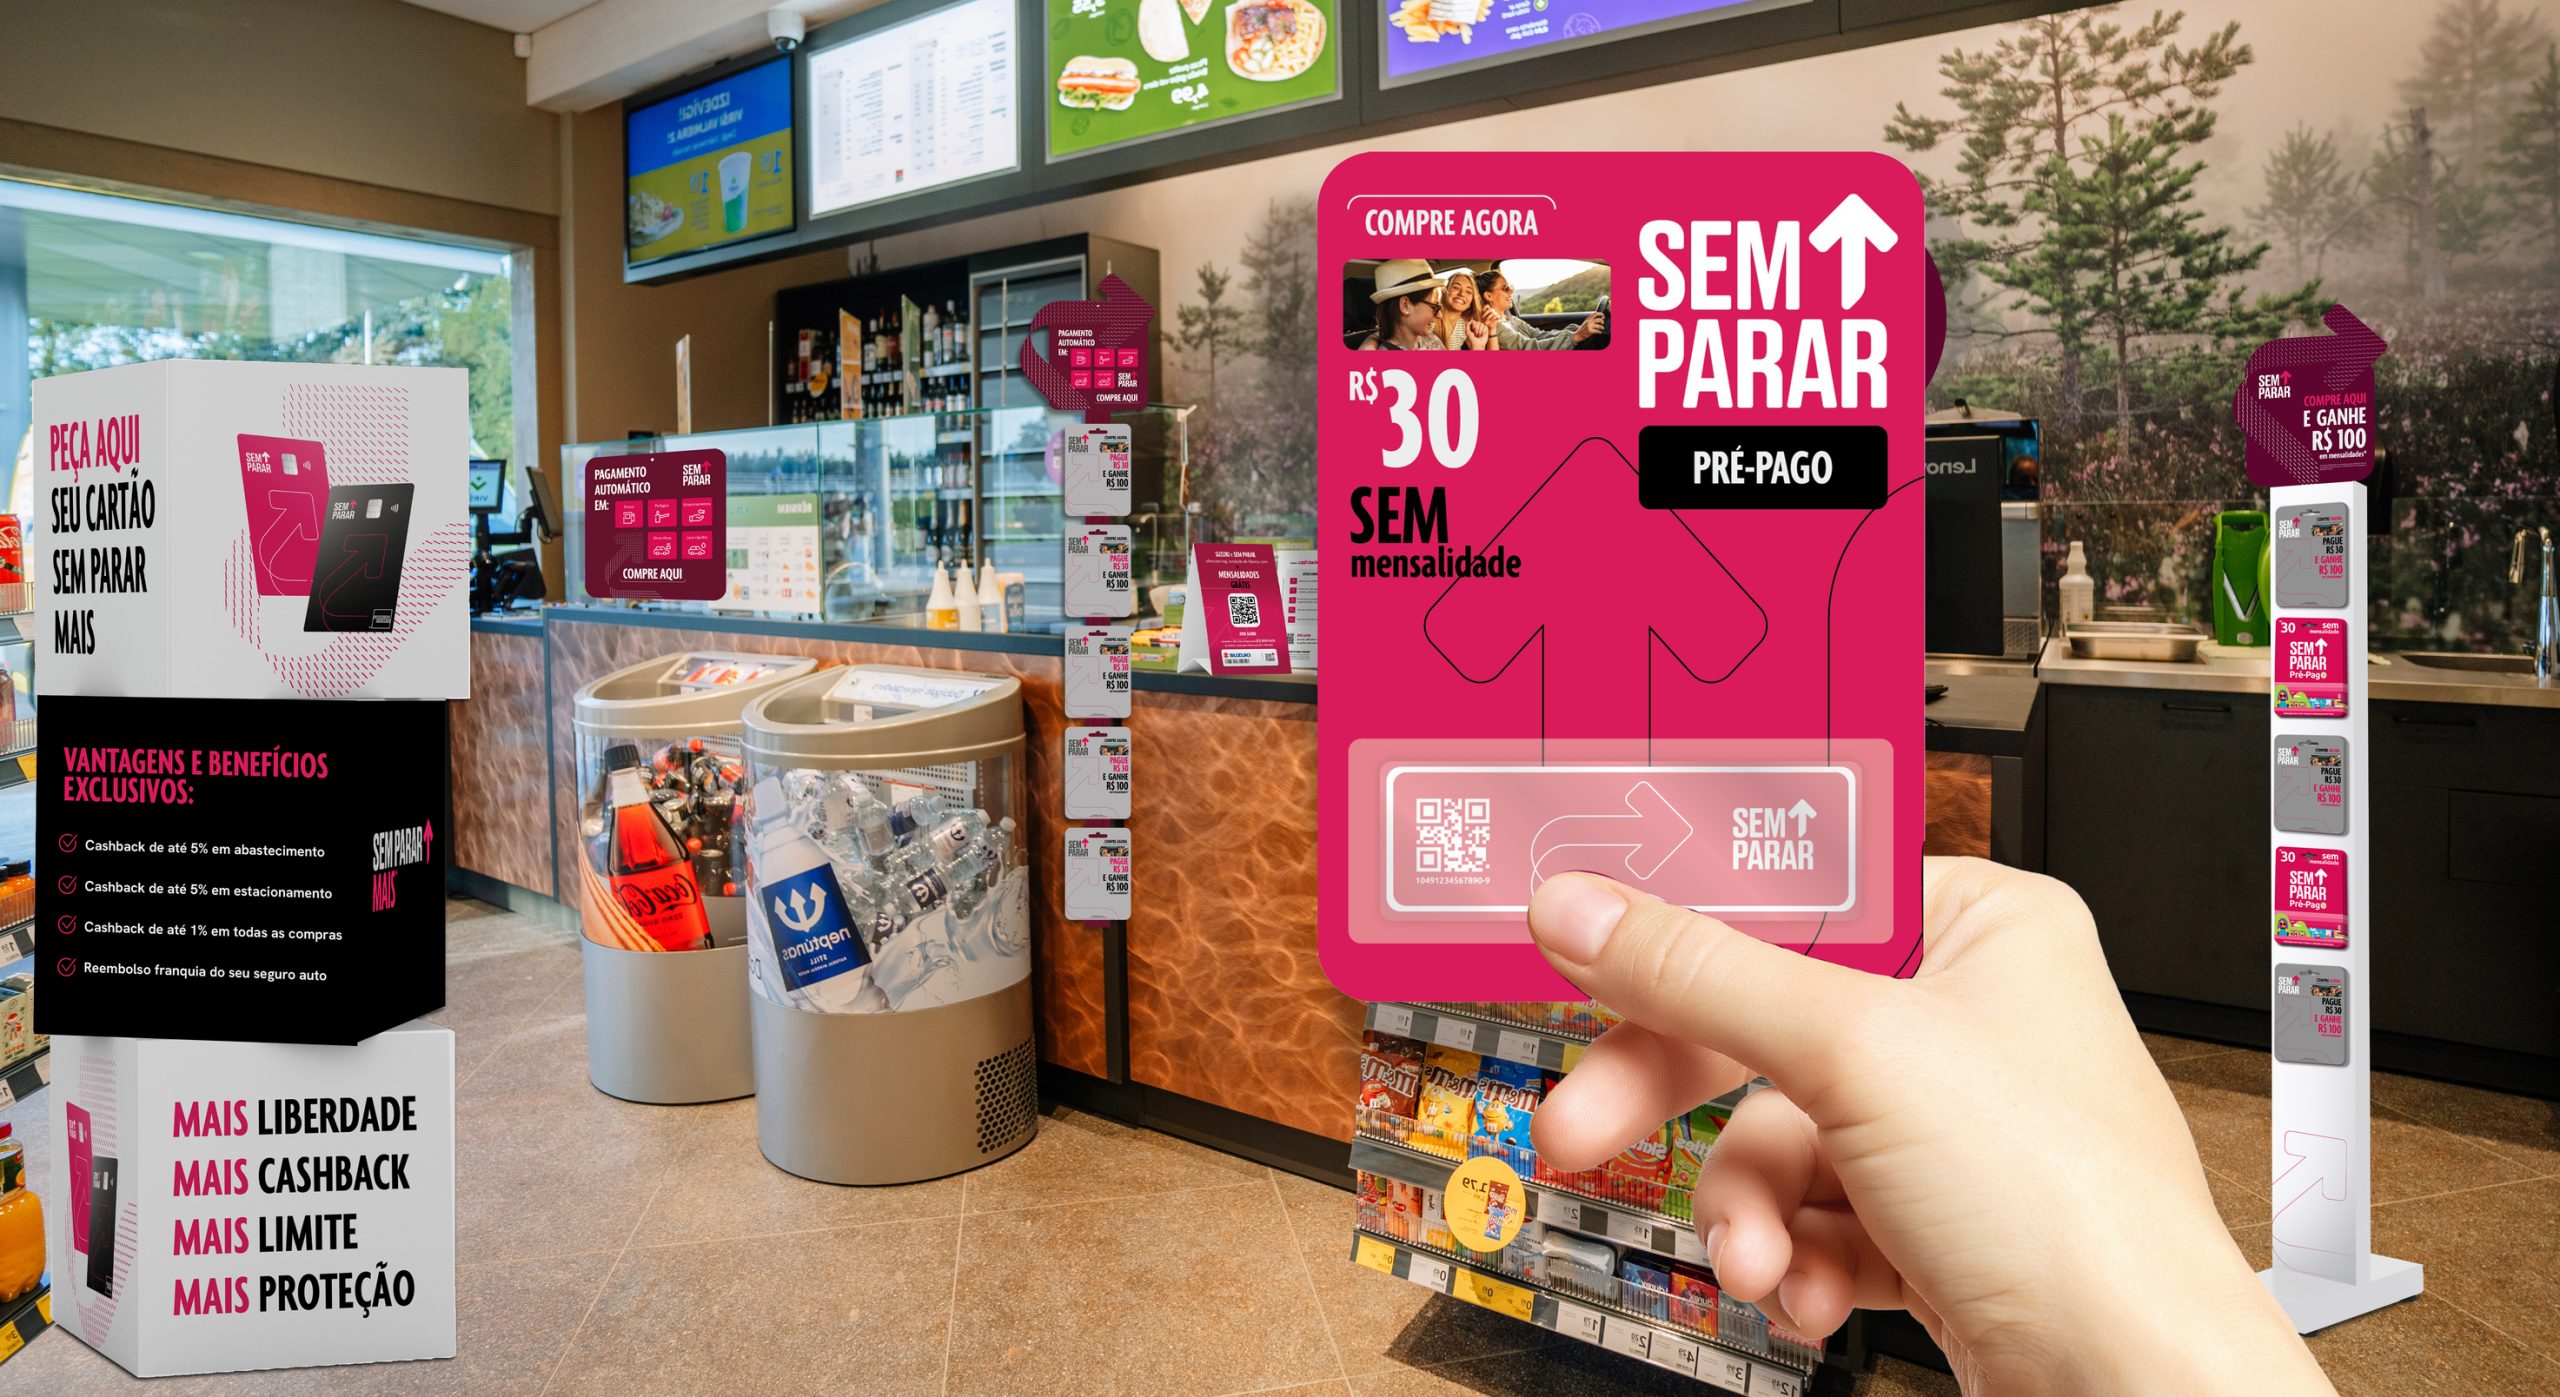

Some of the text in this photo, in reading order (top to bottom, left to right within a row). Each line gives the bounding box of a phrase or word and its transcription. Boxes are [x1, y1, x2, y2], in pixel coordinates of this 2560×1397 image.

[1365, 208, 1539, 237] COMPRE AGORA
[1638, 219, 1801, 311] SEM
[1058, 329, 1093, 337] PAGAMENTO
[1058, 338, 1095, 346] AUTOMÁTICO
[1638, 318, 1888, 409] PARAR
[1118, 380, 1137, 388] PARAR
[2258, 374, 2279, 387] SEM
[1096, 394, 1138, 402] COMPRE AQUI
[2258, 385, 2291, 399] PARAR
[2303, 392, 2366, 407] COMPRE AQUI
[2303, 407, 2366, 427] E GANHE
[1068, 436, 1082, 444] SEM
[2312, 427, 2366, 453] R$ 100
[50, 413, 140, 483] PEÇA AQUI
[1068, 445, 1088, 453] PARAR
[245, 452, 263, 463] SEM
[247, 462, 272, 474] PARAR
[683, 464, 701, 476] SEM
[1113, 461, 1121, 469] R$
[1693, 445, 1833, 485] PRÉ-PAGO
[594, 466, 647, 480] PAGAMENTO
[1108, 470, 1128, 478] GANHE
[683, 474, 711, 486] PARAR
[1106, 478, 1128, 488] R$ 100
[594, 480, 651, 495] AUTOMÁTICO
[51, 469, 155, 534] SEU CARTÃO
[333, 502, 350, 511] SEM
[594, 500, 609, 511] EM:
[332, 510, 356, 520] PARAR
[1350, 486, 1449, 545] SEM
[2279, 520, 2293, 530] SEM
[2279, 528, 2300, 539] PARAR
[2322, 537, 2343, 545] PAGUE
[2326, 546, 2343, 555] R$ 30
[1350, 545, 1522, 579] mensalidade
[2320, 555, 2343, 564] GANHE
[53, 545, 147, 595] SEM PARAR
[623, 568, 682, 581] COMPRE AQUI
[1218, 571, 1260, 579] MENSALIDADES
[2319, 565, 2343, 576] R$ 100
[54, 609, 95, 655] MAIS
[2280, 621, 2296, 633] 30
[2290, 641, 2314, 656] SEM
[2290, 656, 2327, 670] PARAR
[63, 745, 329, 779] VANTAGENS E BENEFÍCIOS
[63, 776, 194, 804] EXCLUSIVOS:
[2320, 785, 2341, 793] GANHE
[2317, 794, 2341, 804] R$ 100
[1732, 807, 1786, 838] SEM
[85, 839, 325, 858] Cashback de até 5% em abastecimento
[372, 825, 424, 871] SEM PARAR
[1068, 840, 1082, 848] SEM
[1068, 848, 1088, 856] PARAR
[1732, 840, 1815, 871] PARAR
[1110, 857, 1128, 865] PAGUE
[1113, 865, 1121, 873] R$
[1415, 876, 1490, 885] 10491234567890-9
[2290, 870, 2314, 886] SEM
[85, 880, 333, 899] Cashback de até 5% em estacionamento
[371, 872, 396, 912] MAIS
[1106, 882, 1128, 892] R$ 100
[2290, 885, 2326, 900] PARAR
[84, 921, 343, 943] Cashback de até 1% em todas as compras
[84, 961, 327, 983] Reembolso franquia do seu seguro auto
[173, 1096, 417, 1138] MAIS LIBERDADE
[173, 1154, 410, 1197] MAIS CASHBACK
[173, 1213, 358, 1256] MAIS LIMITE
[173, 1261, 416, 1319] MAIS PROTEÇÃO
